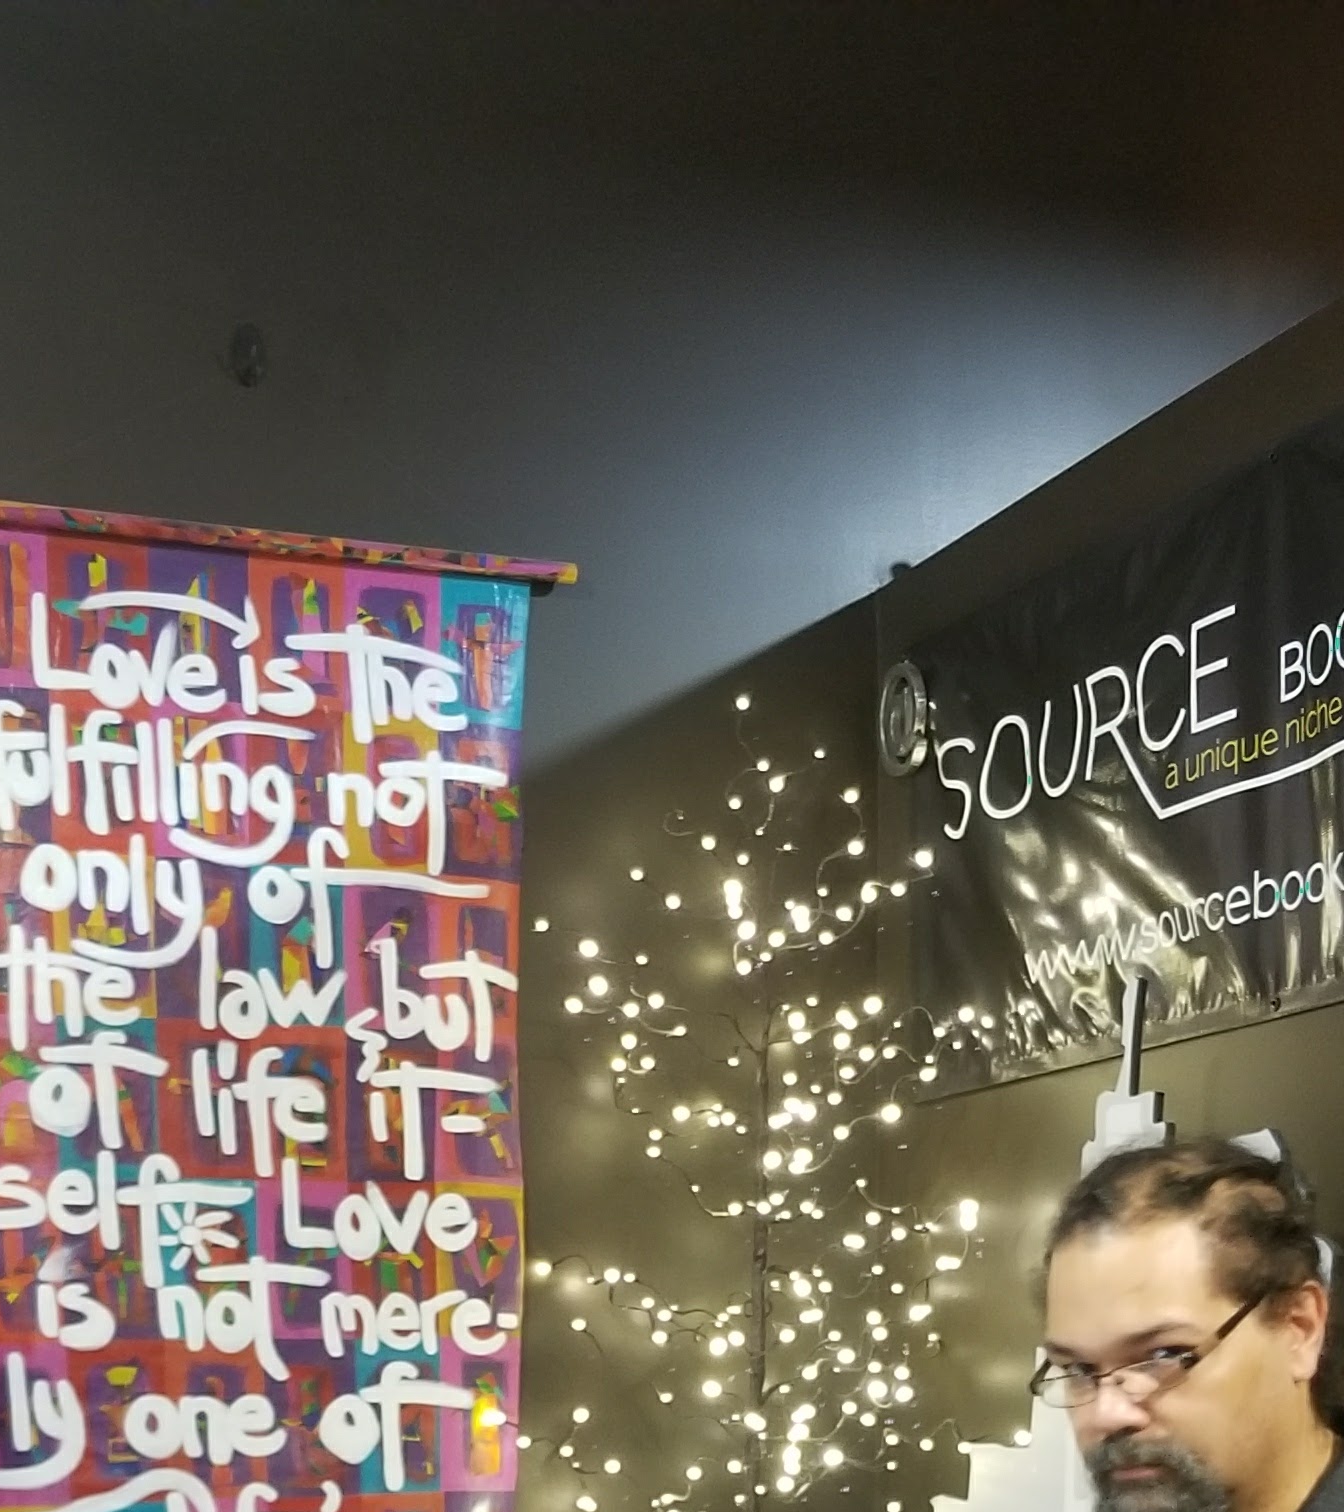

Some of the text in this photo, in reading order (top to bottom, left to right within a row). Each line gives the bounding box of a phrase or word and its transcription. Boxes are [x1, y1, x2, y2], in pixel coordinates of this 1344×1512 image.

[31, 592, 228, 713] Love
[235, 597, 317, 713] is
[935, 603, 1240, 842] SOURCE
[1163, 757, 1180, 792] a
[1183, 726, 1281, 789] unique
[1282, 690, 1344, 748] niche
[328, 750, 508, 875] not
[18, 827, 490, 969] only of
[28, 1030, 169, 1149] of
[190, 1039, 330, 1178] life
[281, 1156, 479, 1262] Love
[36, 1248, 117, 1350] is
[156, 1256, 332, 1381] not
[123, 1392, 288, 1464] one
[319, 1360, 475, 1491] of
